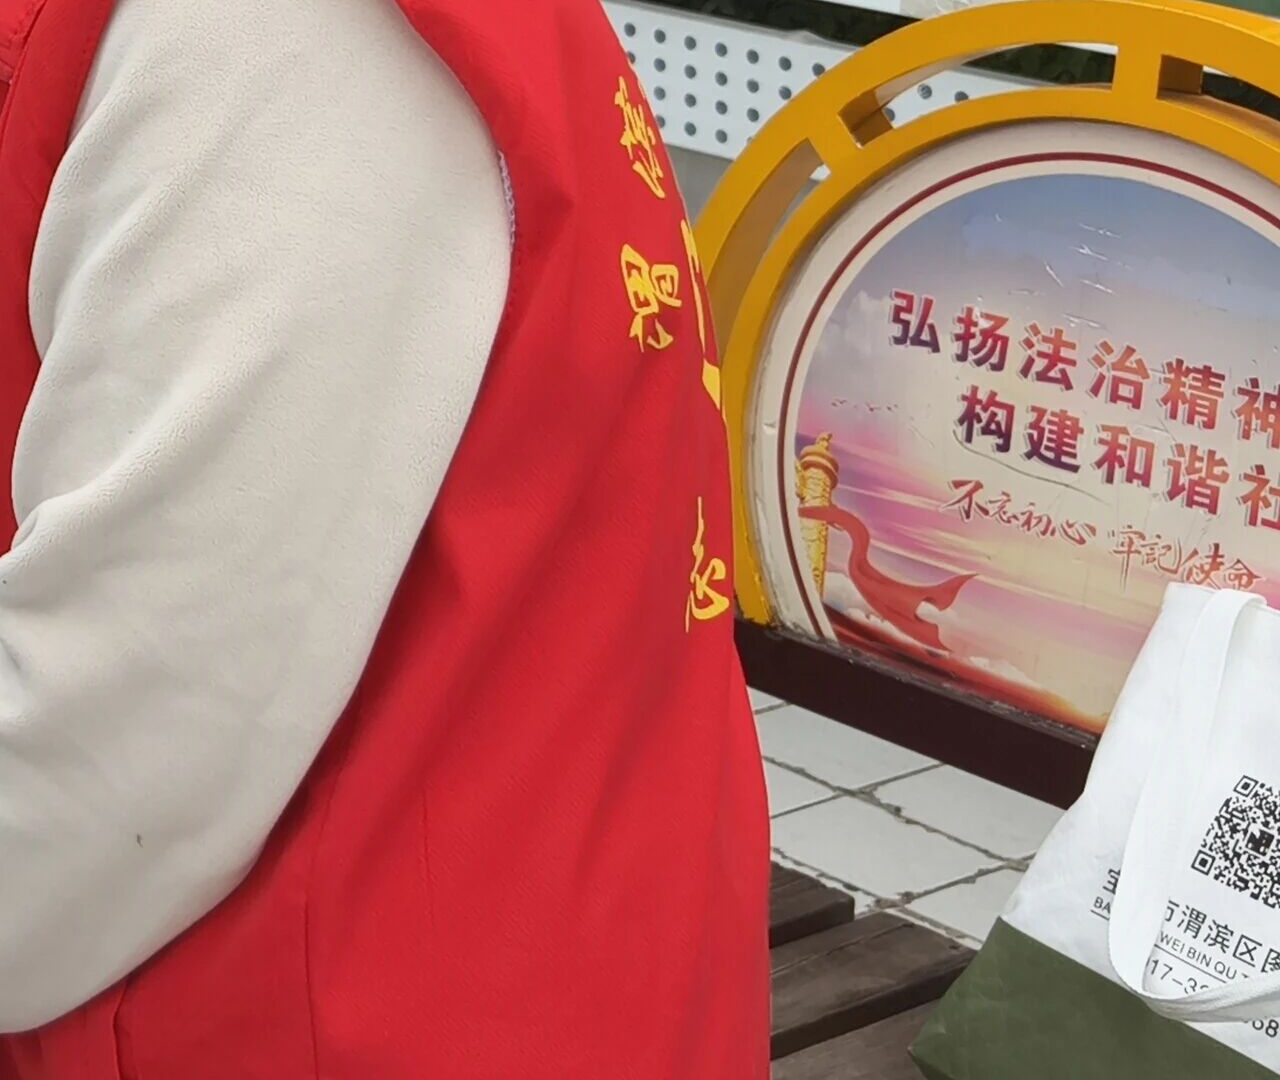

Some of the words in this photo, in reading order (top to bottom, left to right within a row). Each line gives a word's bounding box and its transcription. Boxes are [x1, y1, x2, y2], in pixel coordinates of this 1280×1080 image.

[888, 288, 1280, 451] 弘扬法治精神
[958, 385, 1280, 531] 构建和谐社
[941, 478, 1097, 546] 不忘初心
[1186, 949, 1213, 969] BIN
[1213, 962, 1238, 981] QU
